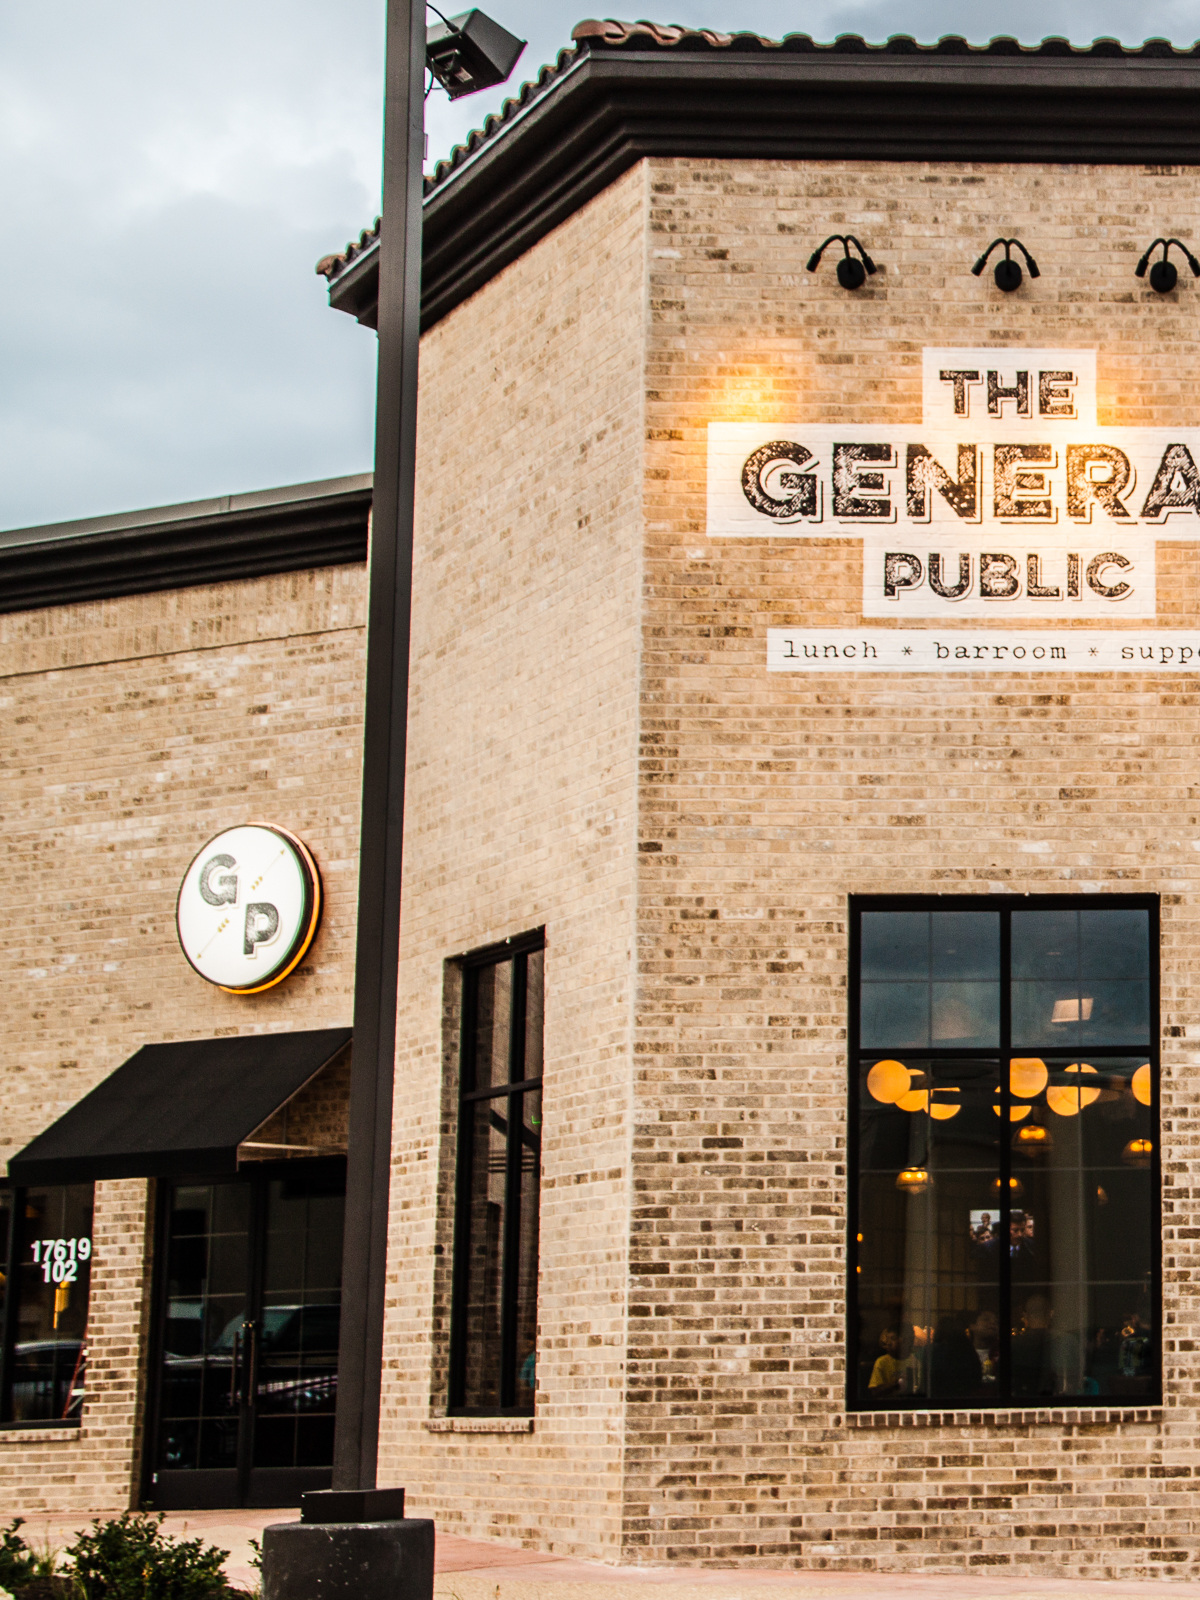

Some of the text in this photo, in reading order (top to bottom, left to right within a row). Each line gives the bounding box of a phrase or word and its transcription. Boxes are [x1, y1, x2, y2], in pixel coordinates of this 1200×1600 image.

[939, 369, 1078, 418] THE
[884, 551, 1134, 601] PUBLIC
[783, 639, 879, 659] lunch
[934, 641, 1067, 660] barroom
[30, 1237, 91, 1262] 17619
[41, 1259, 77, 1283] 102
